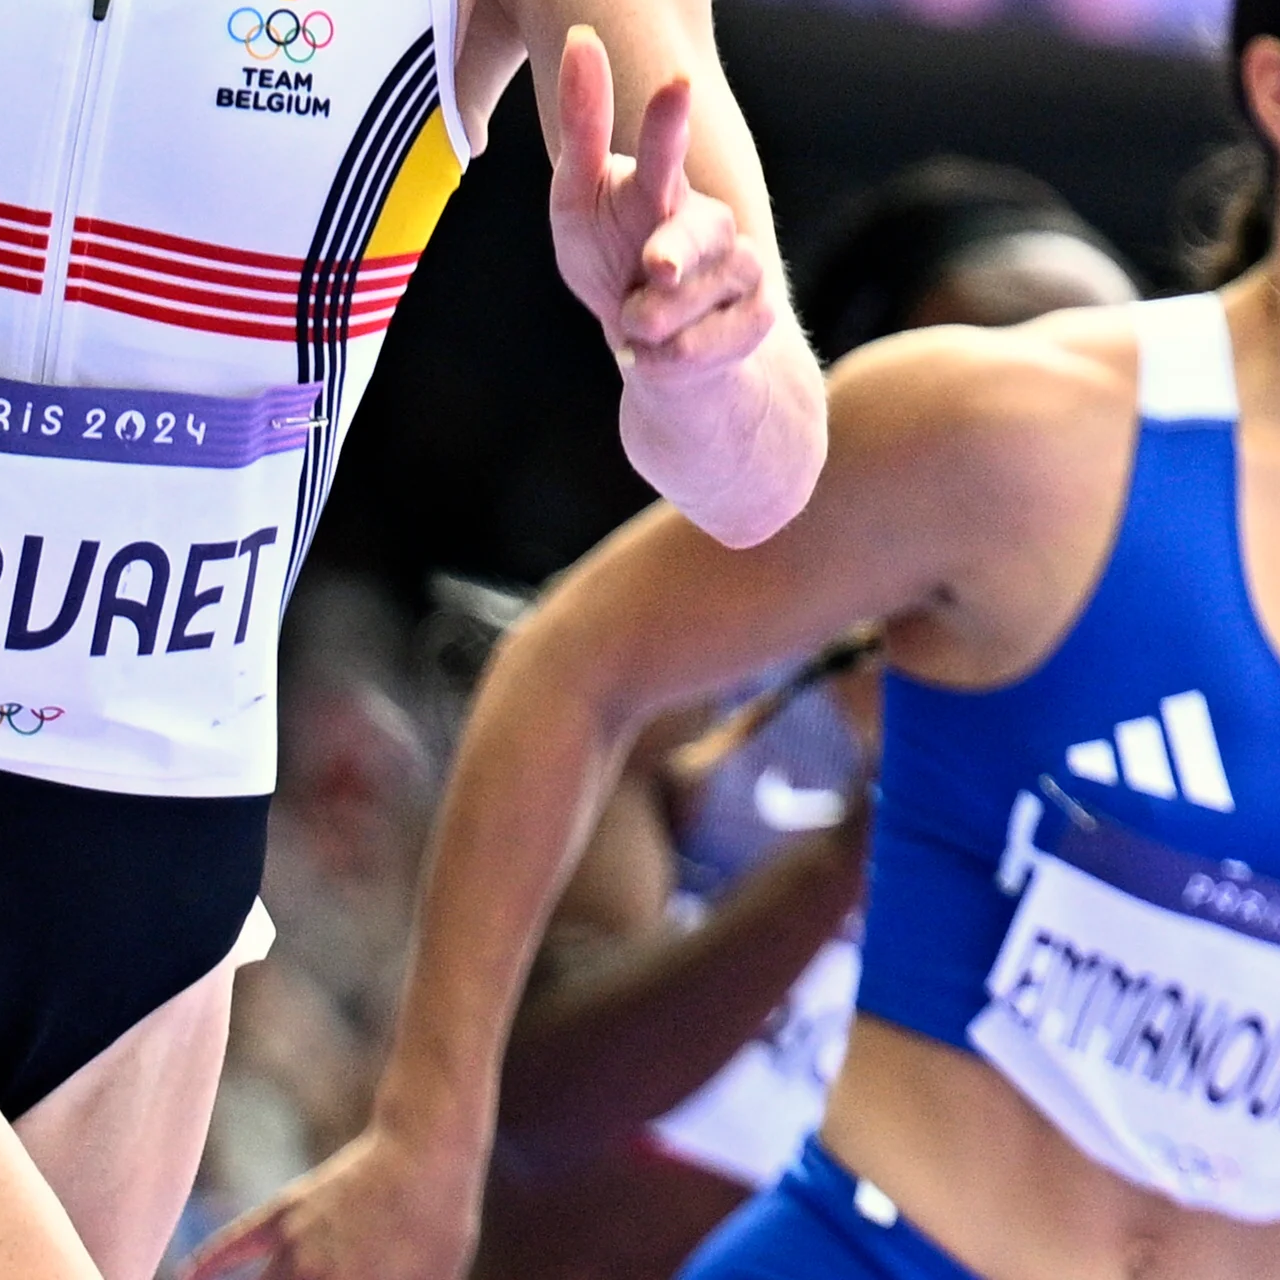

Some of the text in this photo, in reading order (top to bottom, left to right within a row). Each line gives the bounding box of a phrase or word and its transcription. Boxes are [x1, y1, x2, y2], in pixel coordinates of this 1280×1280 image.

[242, 67, 313, 93] TEAM
[216, 87, 331, 117] BELGIUM
[82, 407, 207, 446] 2024
